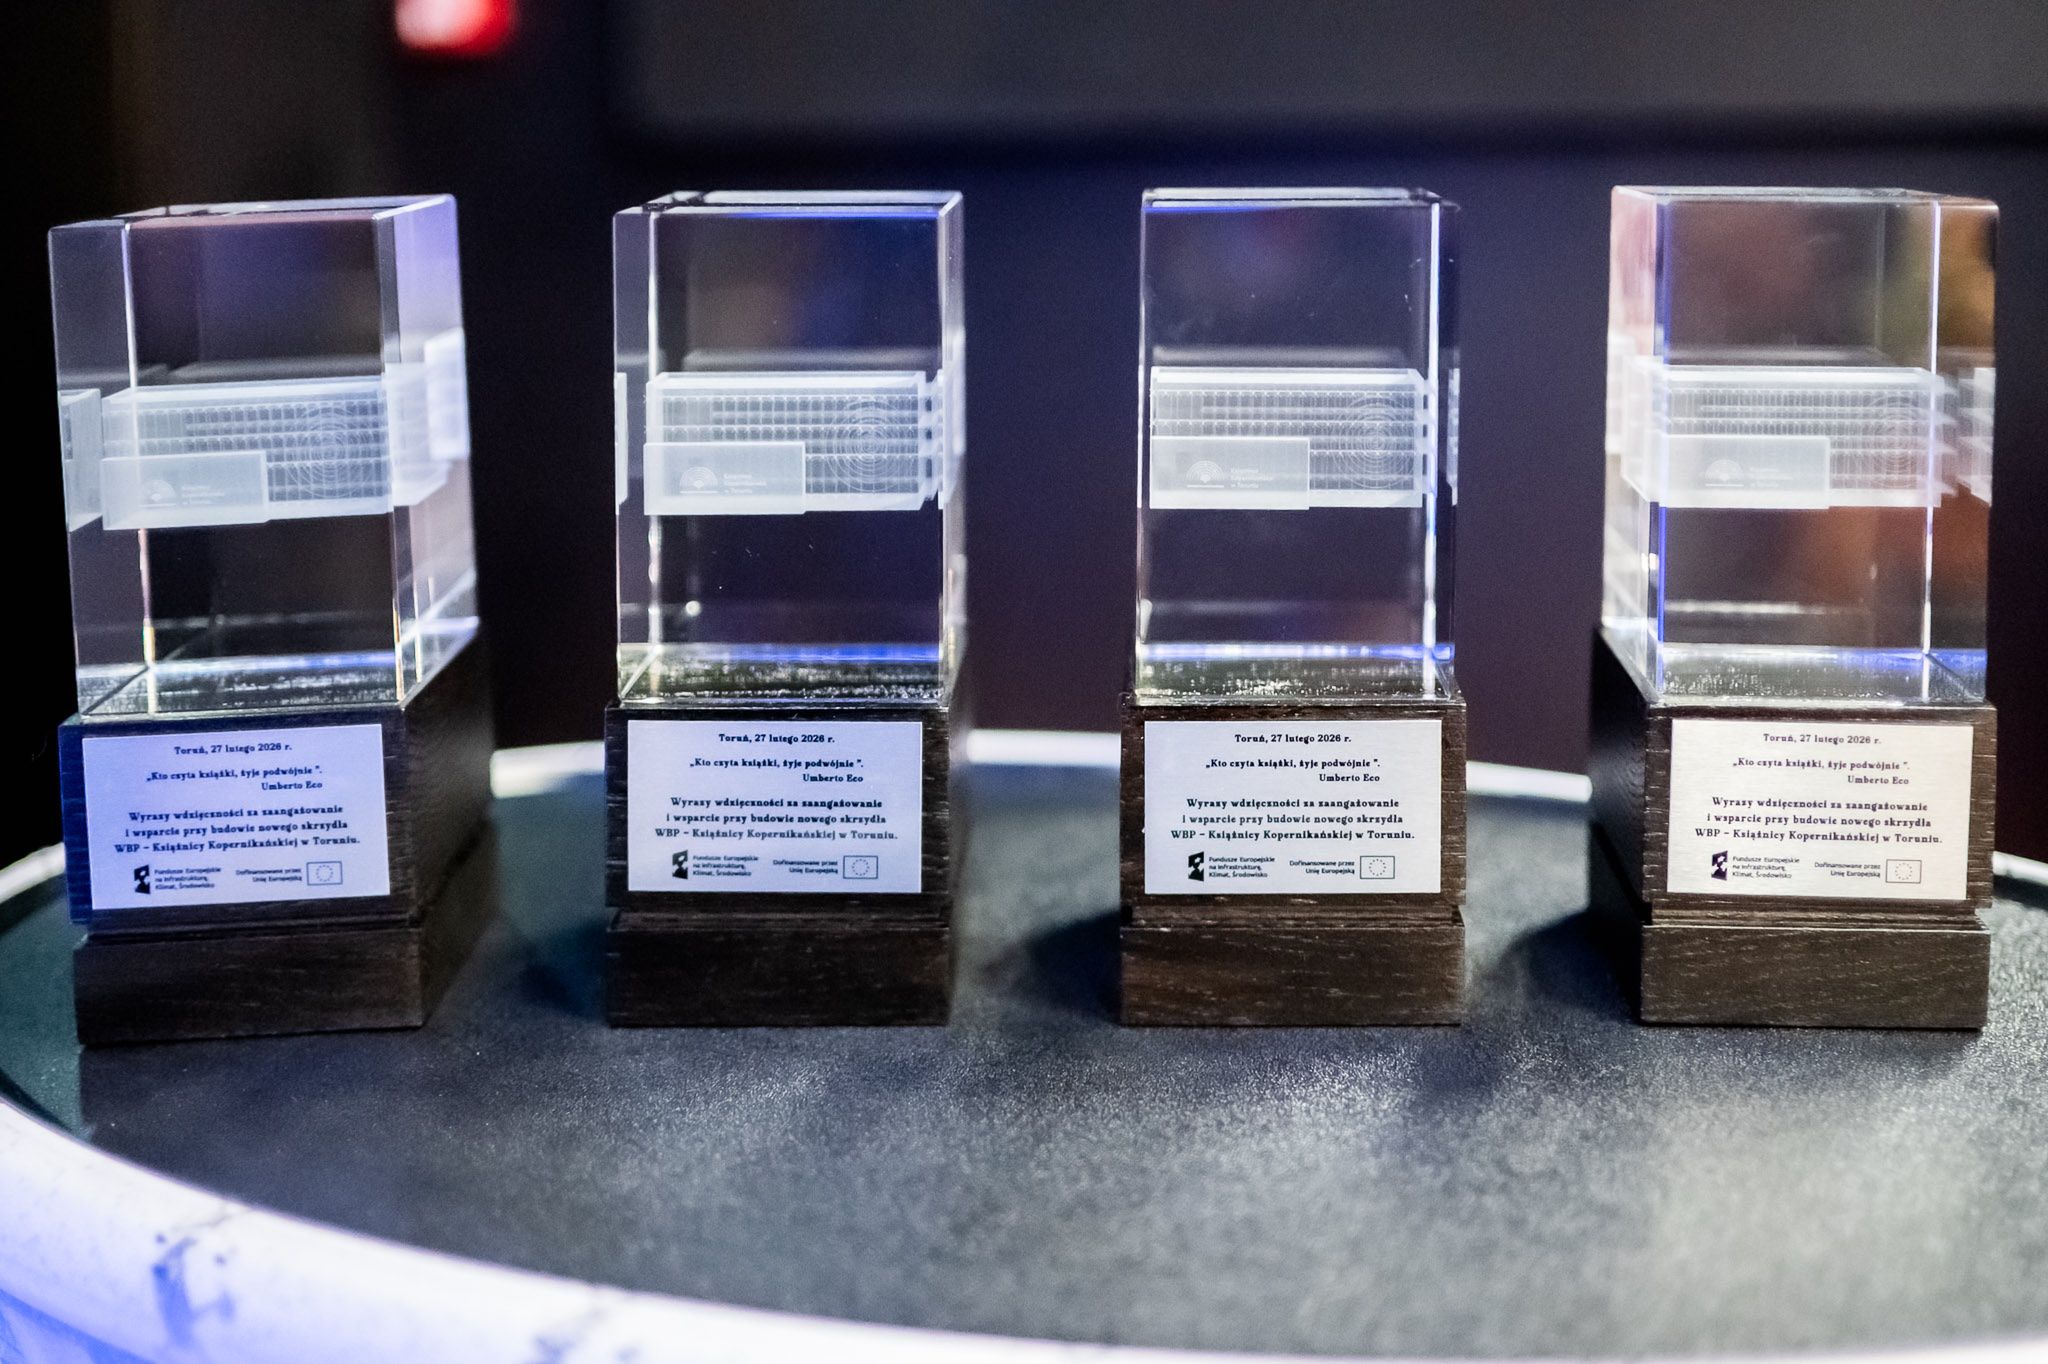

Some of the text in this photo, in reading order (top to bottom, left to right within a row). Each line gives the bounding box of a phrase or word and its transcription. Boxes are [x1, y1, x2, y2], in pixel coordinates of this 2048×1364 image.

[754, 733, 766, 742] 27
[769, 733, 799, 745] lutego
[1234, 734, 1268, 744] Toruń,
[1270, 734, 1283, 742] 27
[1285, 734, 1315, 745] lutego
[1317, 733, 1341, 742] 2026
[1763, 733, 1797, 743] Toruń,
[1799, 734, 1811, 742] 27
[1814, 734, 1844, 746] lutego
[210, 744, 223, 753] 27
[782, 759, 802, 769] żyje
[1229, 760, 1255, 769] czyta
[1299, 759, 1318, 769] żyje
[1321, 758, 1370, 770] podwójnie
[1757, 760, 1782, 768] czyta
[1828, 760, 1847, 770] żyje
[802, 773, 864, 782] Umberto Eco
[1319, 773, 1380, 782] Umberto Eco
[1847, 775, 1909, 785] Umberto Eco
[261, 780, 323, 791] Umberto Eco
[1186, 798, 1227, 810] Wyrazy
[1230, 798, 1300, 810] wdzięczności
[797, 815, 837, 826] nowego
[1182, 814, 1403, 826] i wsparcie przy budowie nowego skrzydła
[1707, 813, 1931, 829] i wsparcie przy budowie nowego skrzydła
[655, 828, 680, 837] WBP
[850, 830, 898, 839] Toruniu.
[1170, 830, 1196, 839] WBP
[1263, 830, 1352, 842] Kopernikańskiej
[1367, 830, 1415, 839] Toruniu.
[1695, 828, 1720, 837] WBP
[1894, 833, 1942, 843] Toruniu.
[114, 843, 140, 853] WBP
